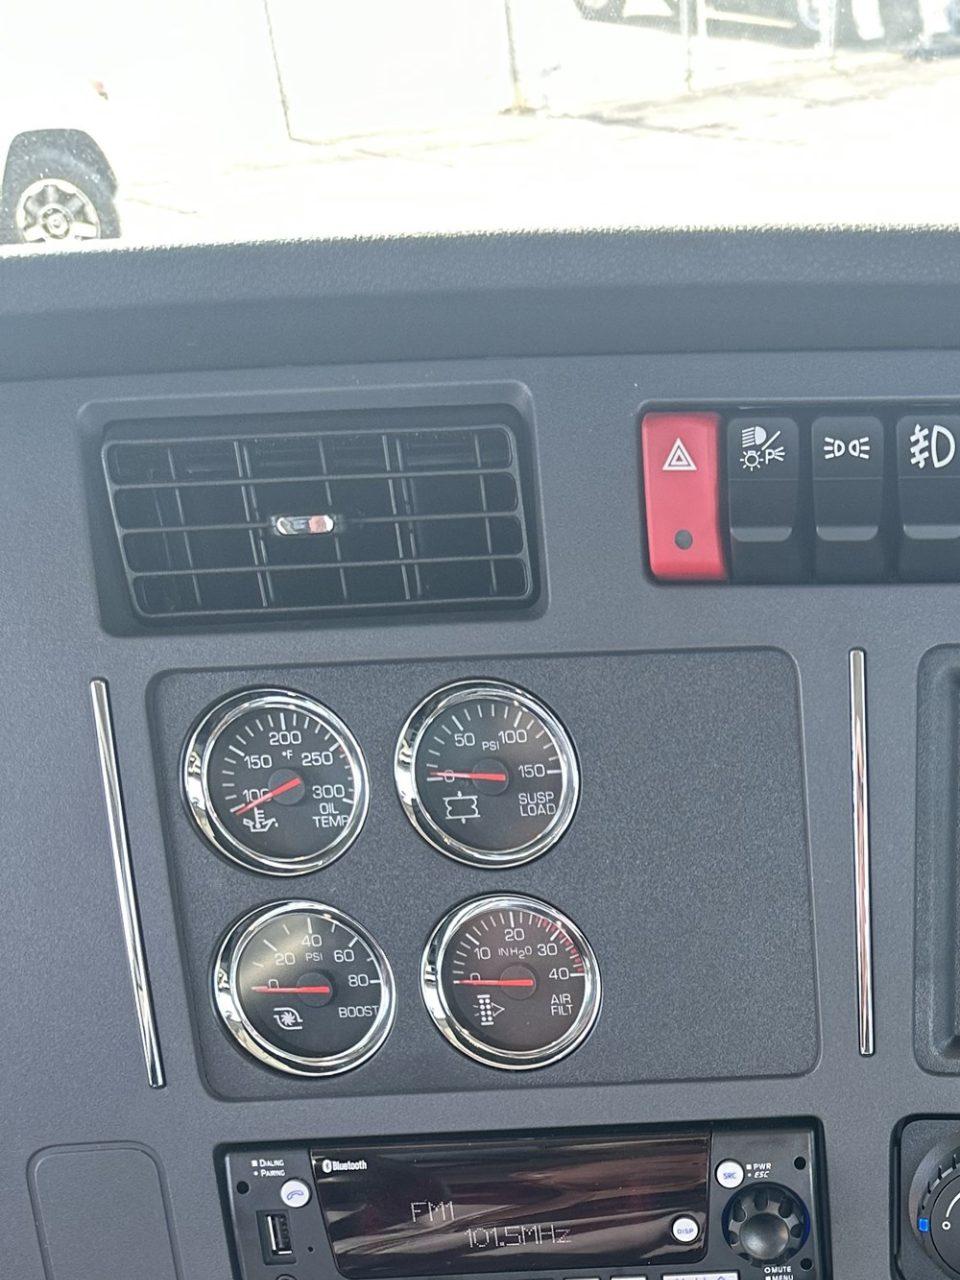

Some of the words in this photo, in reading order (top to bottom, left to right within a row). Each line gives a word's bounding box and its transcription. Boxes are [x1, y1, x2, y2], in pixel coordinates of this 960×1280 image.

[269, 731, 302, 745] 200
[454, 732, 476, 746] 50
[498, 730, 528, 744] 100
[482, 741, 500, 751] PSI
[244, 754, 272, 768] 150
[302, 752, 333, 766] 250
[518, 764, 546, 778] 150
[242, 788, 272, 802] 100
[312, 784, 345, 798] 300
[518, 792, 554, 805] SUSP
[319, 803, 339, 814] OIL
[520, 804, 556, 817] LOAD
[312, 816, 349, 828] TEMP
[302, 934, 322, 947] 40
[504, 928, 524, 942] 20
[334, 950, 354, 962] 60
[474, 946, 491, 960] 10
[537, 944, 558, 956] 30
[274, 952, 296, 966] 20
[306, 953, 323, 962] PSI
[348, 974, 368, 987] 80
[548, 968, 569, 980] 40
[550, 994, 571, 1004] AIR
[338, 1006, 379, 1018] BOOST
[551, 1005, 573, 1016] FILT
[332, 1160, 367, 1171] Bluetooth
[753, 1162, 772, 1170] PWR
[464, 1224, 572, 1248] 101.5MHz
